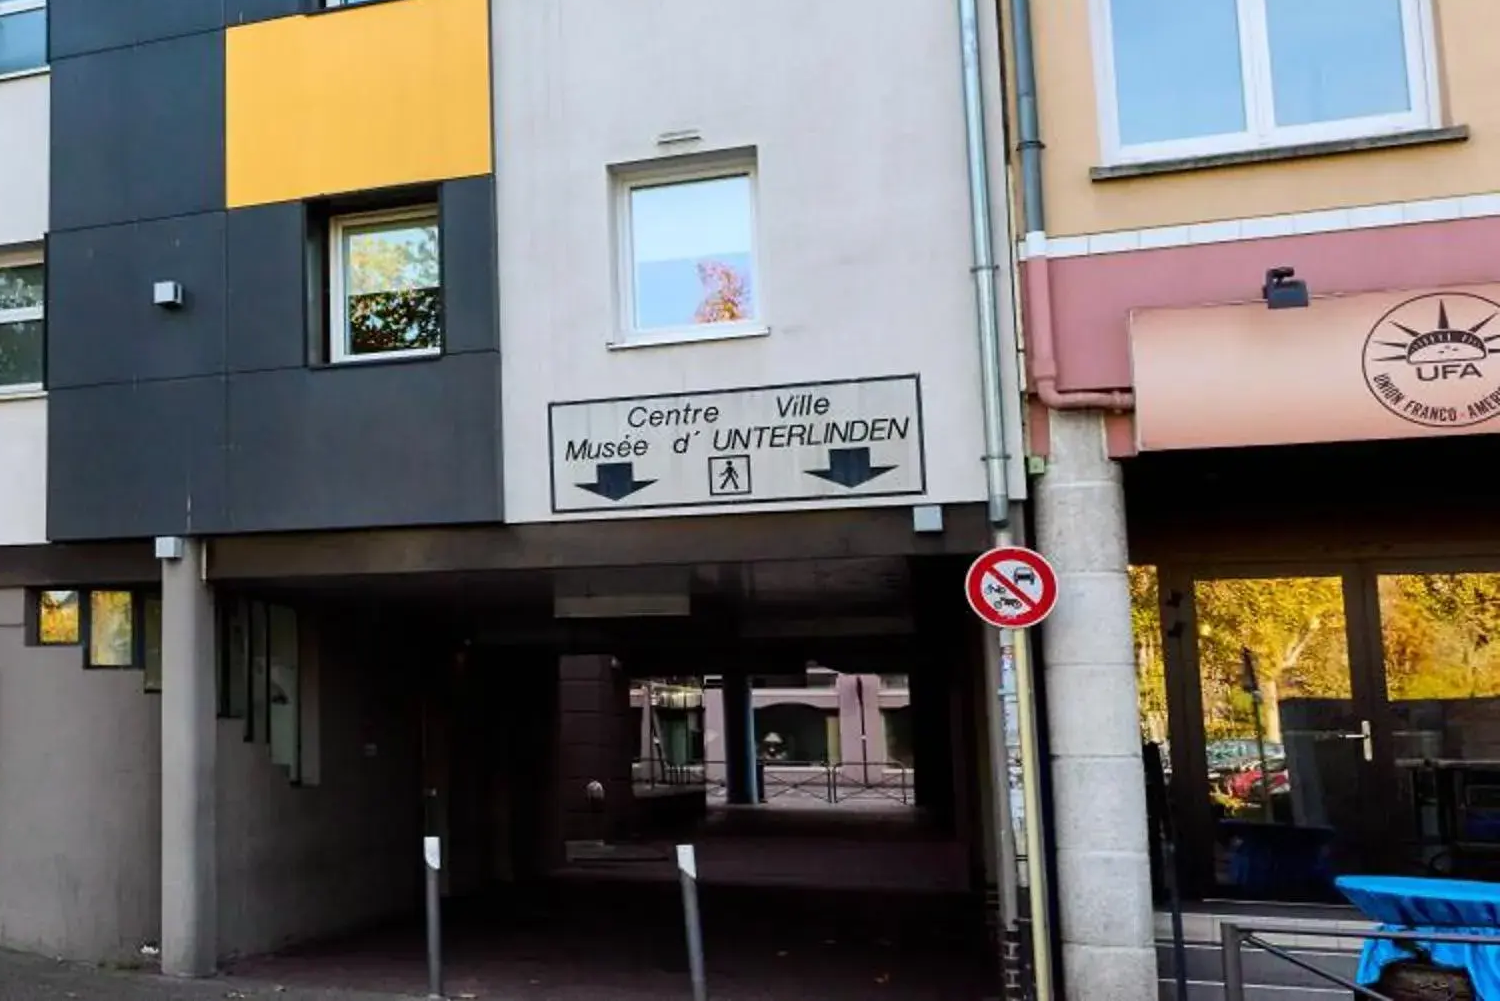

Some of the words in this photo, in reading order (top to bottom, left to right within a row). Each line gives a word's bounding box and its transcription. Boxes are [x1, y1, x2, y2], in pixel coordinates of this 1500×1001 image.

[1416, 363, 1483, 381] UFA
[627, 401, 719, 428] Centre
[776, 396, 830, 418] Ville
[1373, 373, 1405, 406] UNION
[1403, 400, 1457, 421] FRANCO
[565, 435, 649, 462] Musée
[712, 417, 910, 451] UNTERLINDEN
